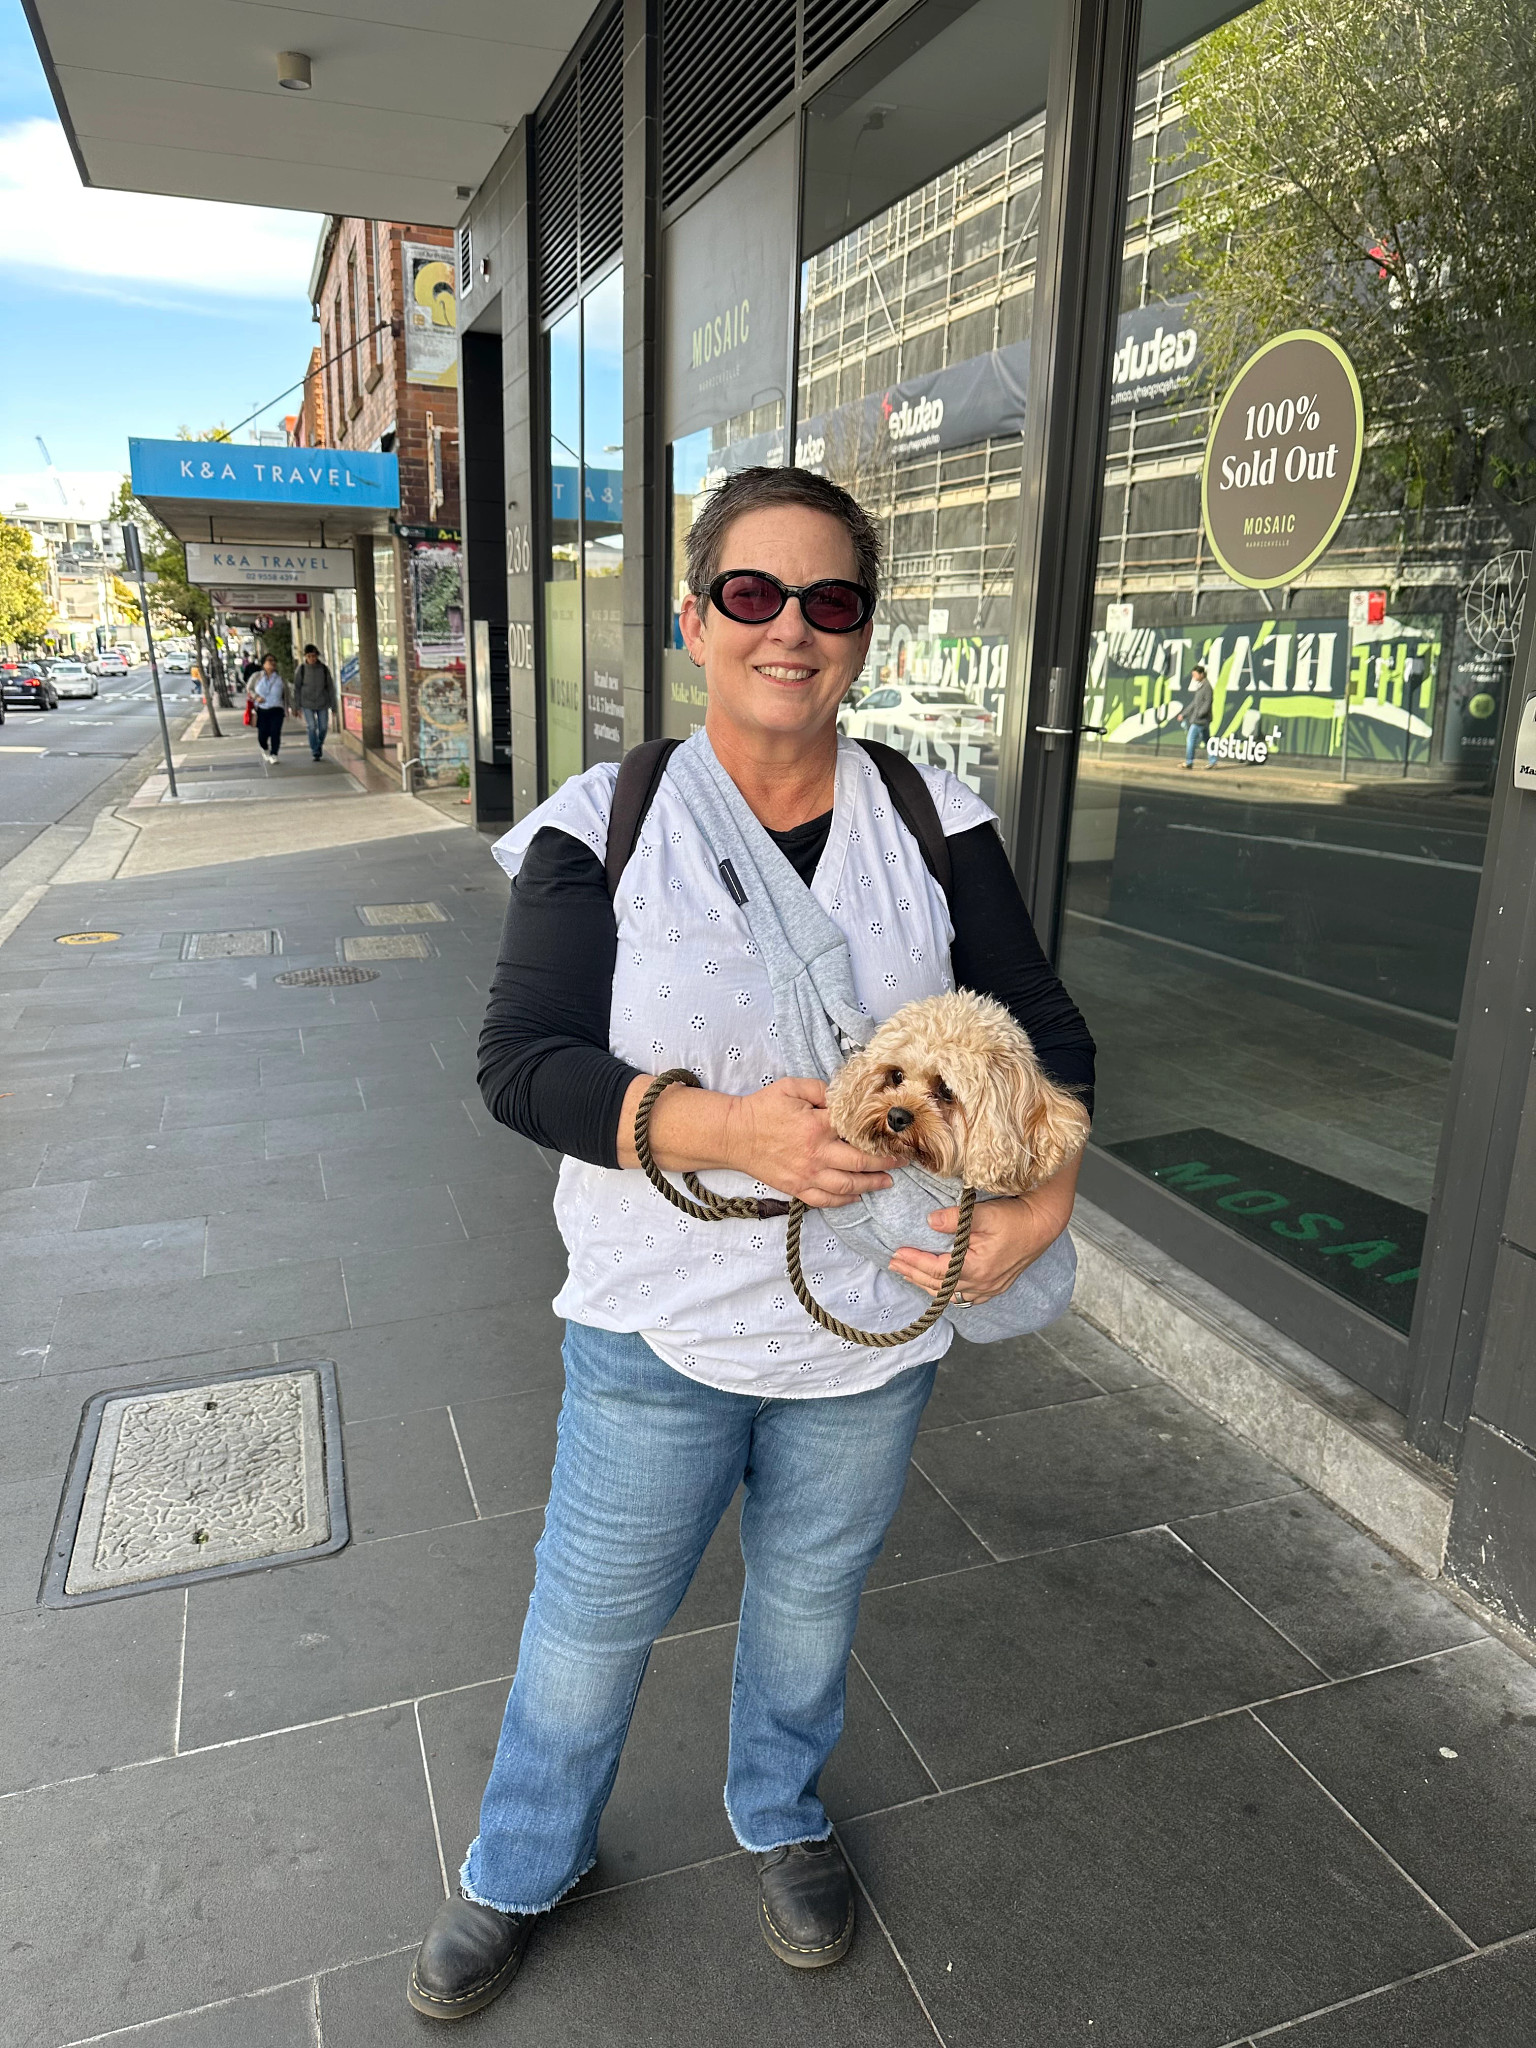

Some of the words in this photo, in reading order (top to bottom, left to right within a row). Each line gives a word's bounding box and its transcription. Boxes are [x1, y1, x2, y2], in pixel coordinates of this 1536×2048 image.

[692, 299, 750, 369] MOSAIC
[1244, 393, 1321, 441] 100%
[180, 460, 237, 481] K&A
[253, 464, 356, 488] TRAVEL
[1219, 447, 1278, 491] Sold
[1284, 443, 1339, 483] Out
[1243, 513, 1296, 536] MOSAIC
[213, 553, 250, 567] K&A
[261, 555, 329, 570] TRAVEL
[506, 525, 531, 574] 236
[245, 572, 256, 580] 02
[508, 622, 532, 670] ODE
